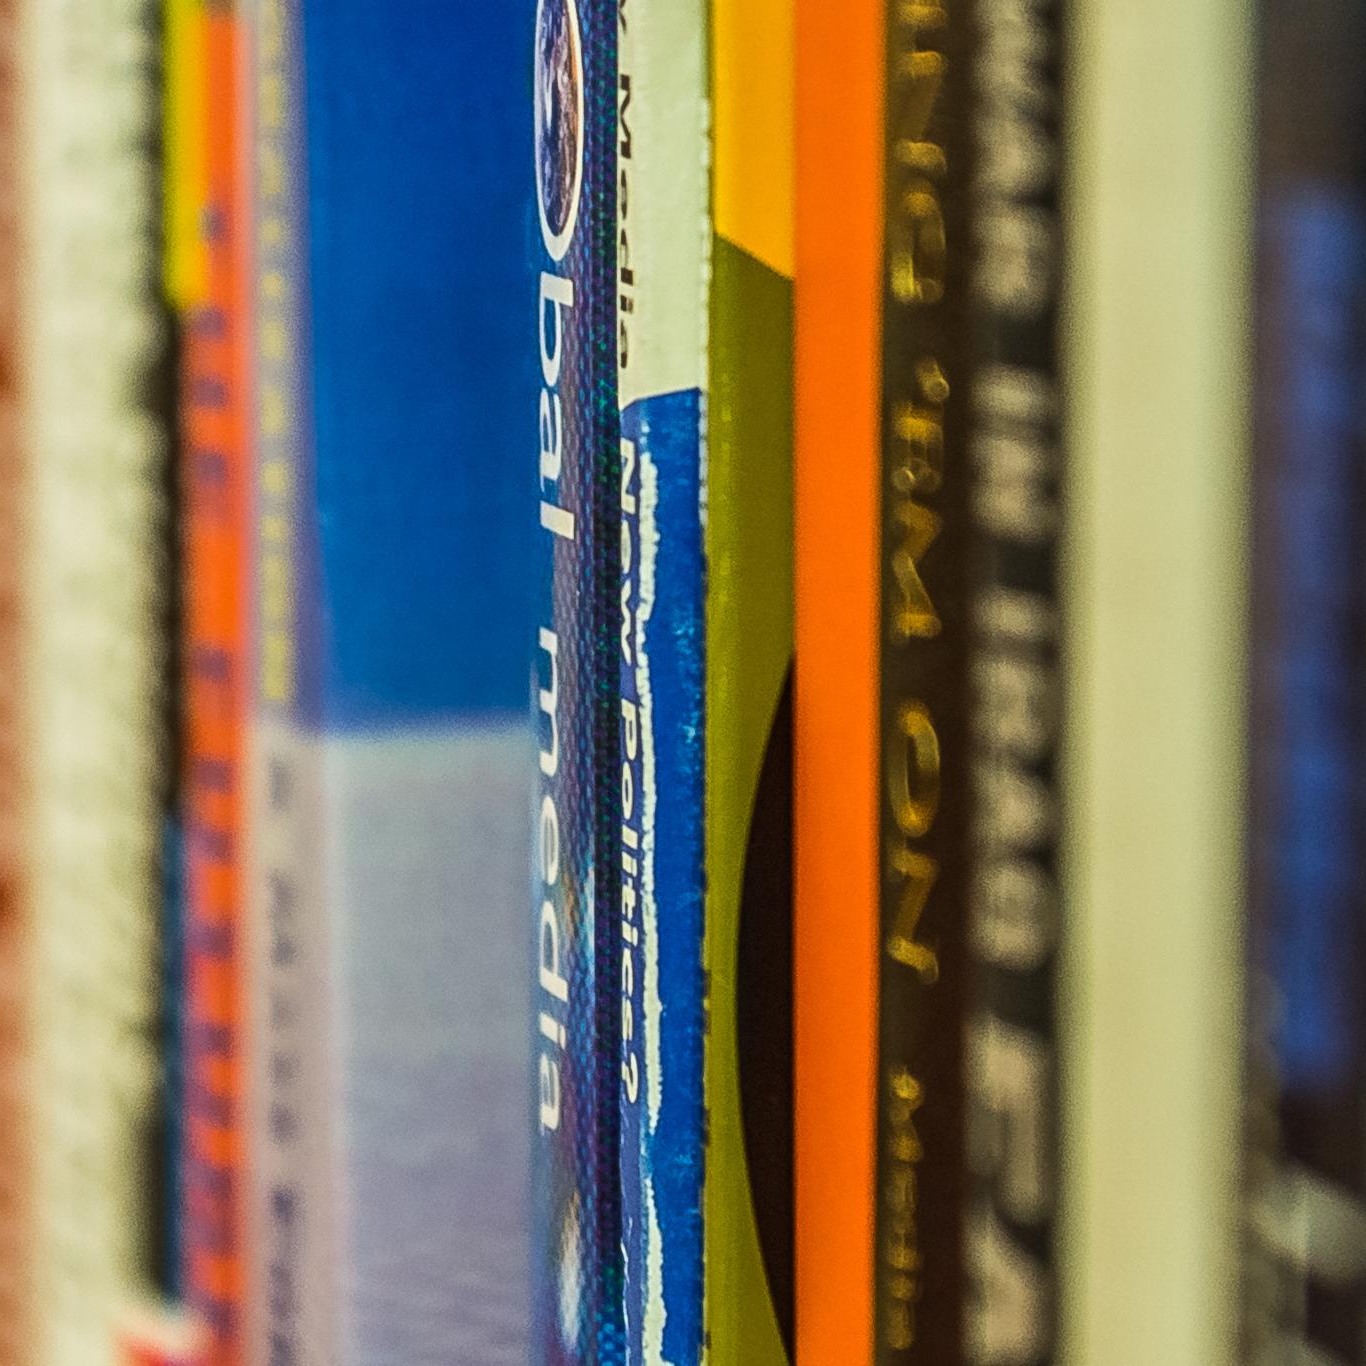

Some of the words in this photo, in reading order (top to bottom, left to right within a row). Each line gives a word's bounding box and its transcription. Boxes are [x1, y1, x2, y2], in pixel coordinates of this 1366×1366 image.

[620, 74, 634, 370] Media
[620, 437, 636, 667] New
[538, 626, 569, 1134] media
[621, 697, 639, 1104] Politics?
[886, 698, 941, 985] ON
